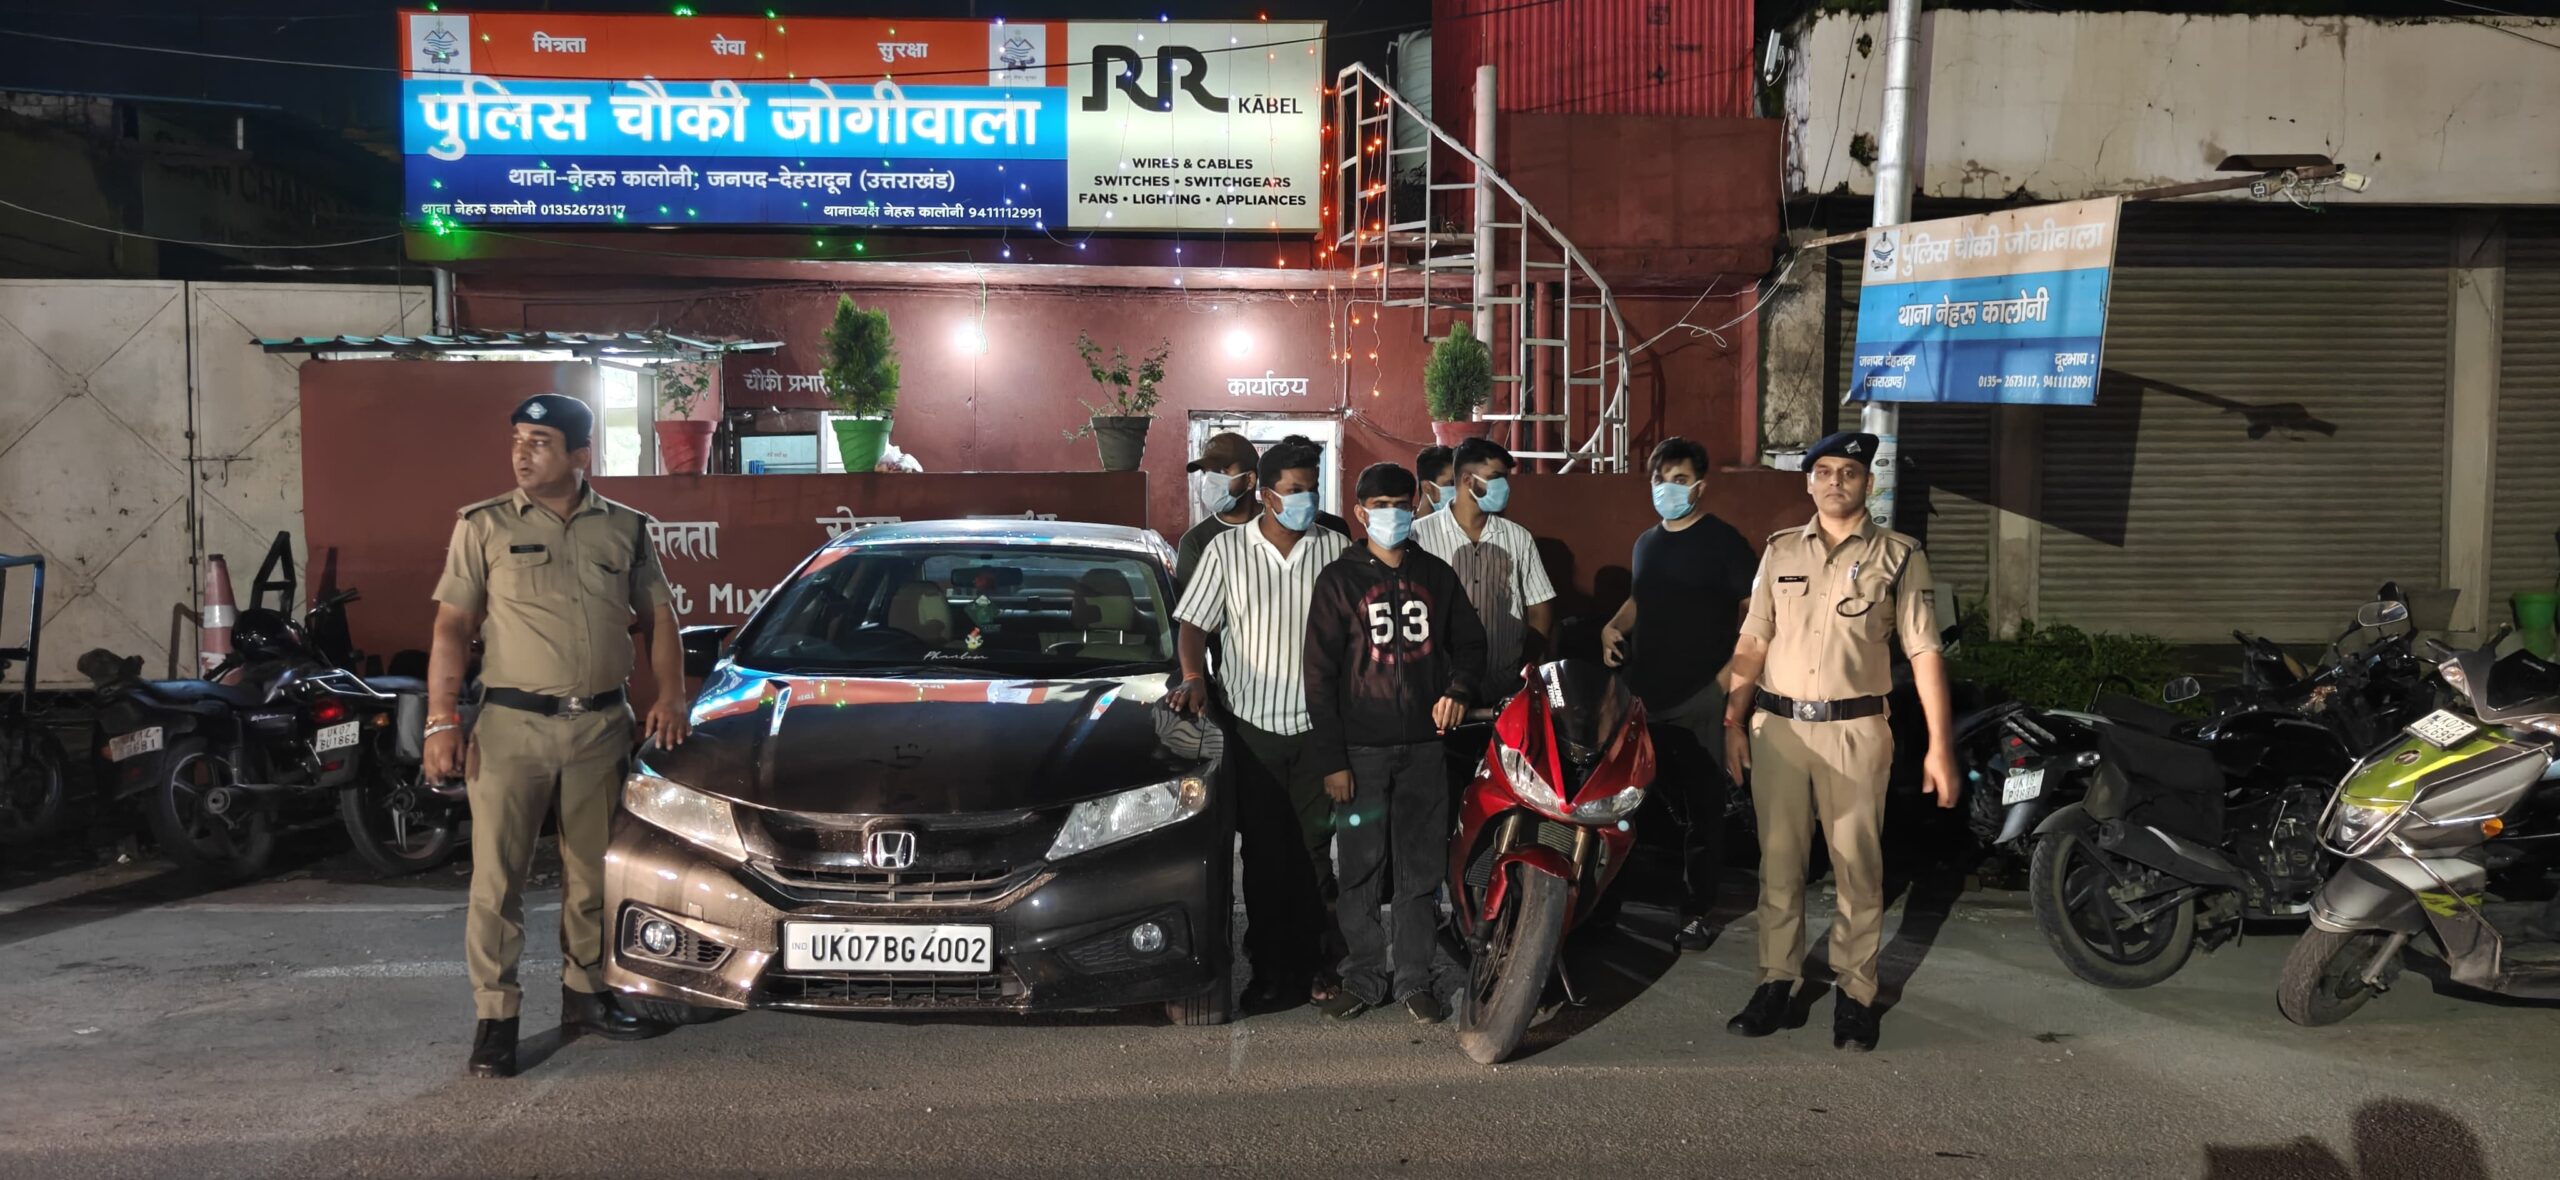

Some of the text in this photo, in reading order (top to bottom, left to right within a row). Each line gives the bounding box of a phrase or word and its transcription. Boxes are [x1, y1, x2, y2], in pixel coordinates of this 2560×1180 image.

[533, 32, 587, 54] मित्रता
[711, 36, 746, 57] सेवा
[878, 39, 928, 61] सुरक्षा
[1082, 44, 1229, 112] RR
[418, 74, 1041, 161] पुलिस चौकी जोगीवाला
[1133, 158, 1253, 169] WIRES & CABLES
[860, 168, 956, 192] (उत्तराखंड)
[1094, 175, 1291, 188] SWITCHES SWITCHGEARS
[421, 200, 626, 216] थाना नेहरू कालोनी 01352673117
[884, 202, 914, 217] नेहरू
[918, 203, 964, 218] कालोनी
[968, 207, 1042, 218] 9411112991
[1079, 193, 1307, 206] FANS LIGHTING APPLIANCES
[1901, 232, 1950, 277] पुलिस
[2005, 218, 2106, 254] जोगीवाला
[1898, 286, 2049, 329] थाना नेहरू कालोनी
[1859, 351, 1916, 372] जनपद देहरादून
[2054, 352, 2088, 373] दूरभाष
[743, 368, 831, 395] चौकी प्रभार
[1227, 370, 1308, 397] कार्यालय
[1368, 600, 1429, 644] 53
[811, 935, 986, 963] UK07BG4002
